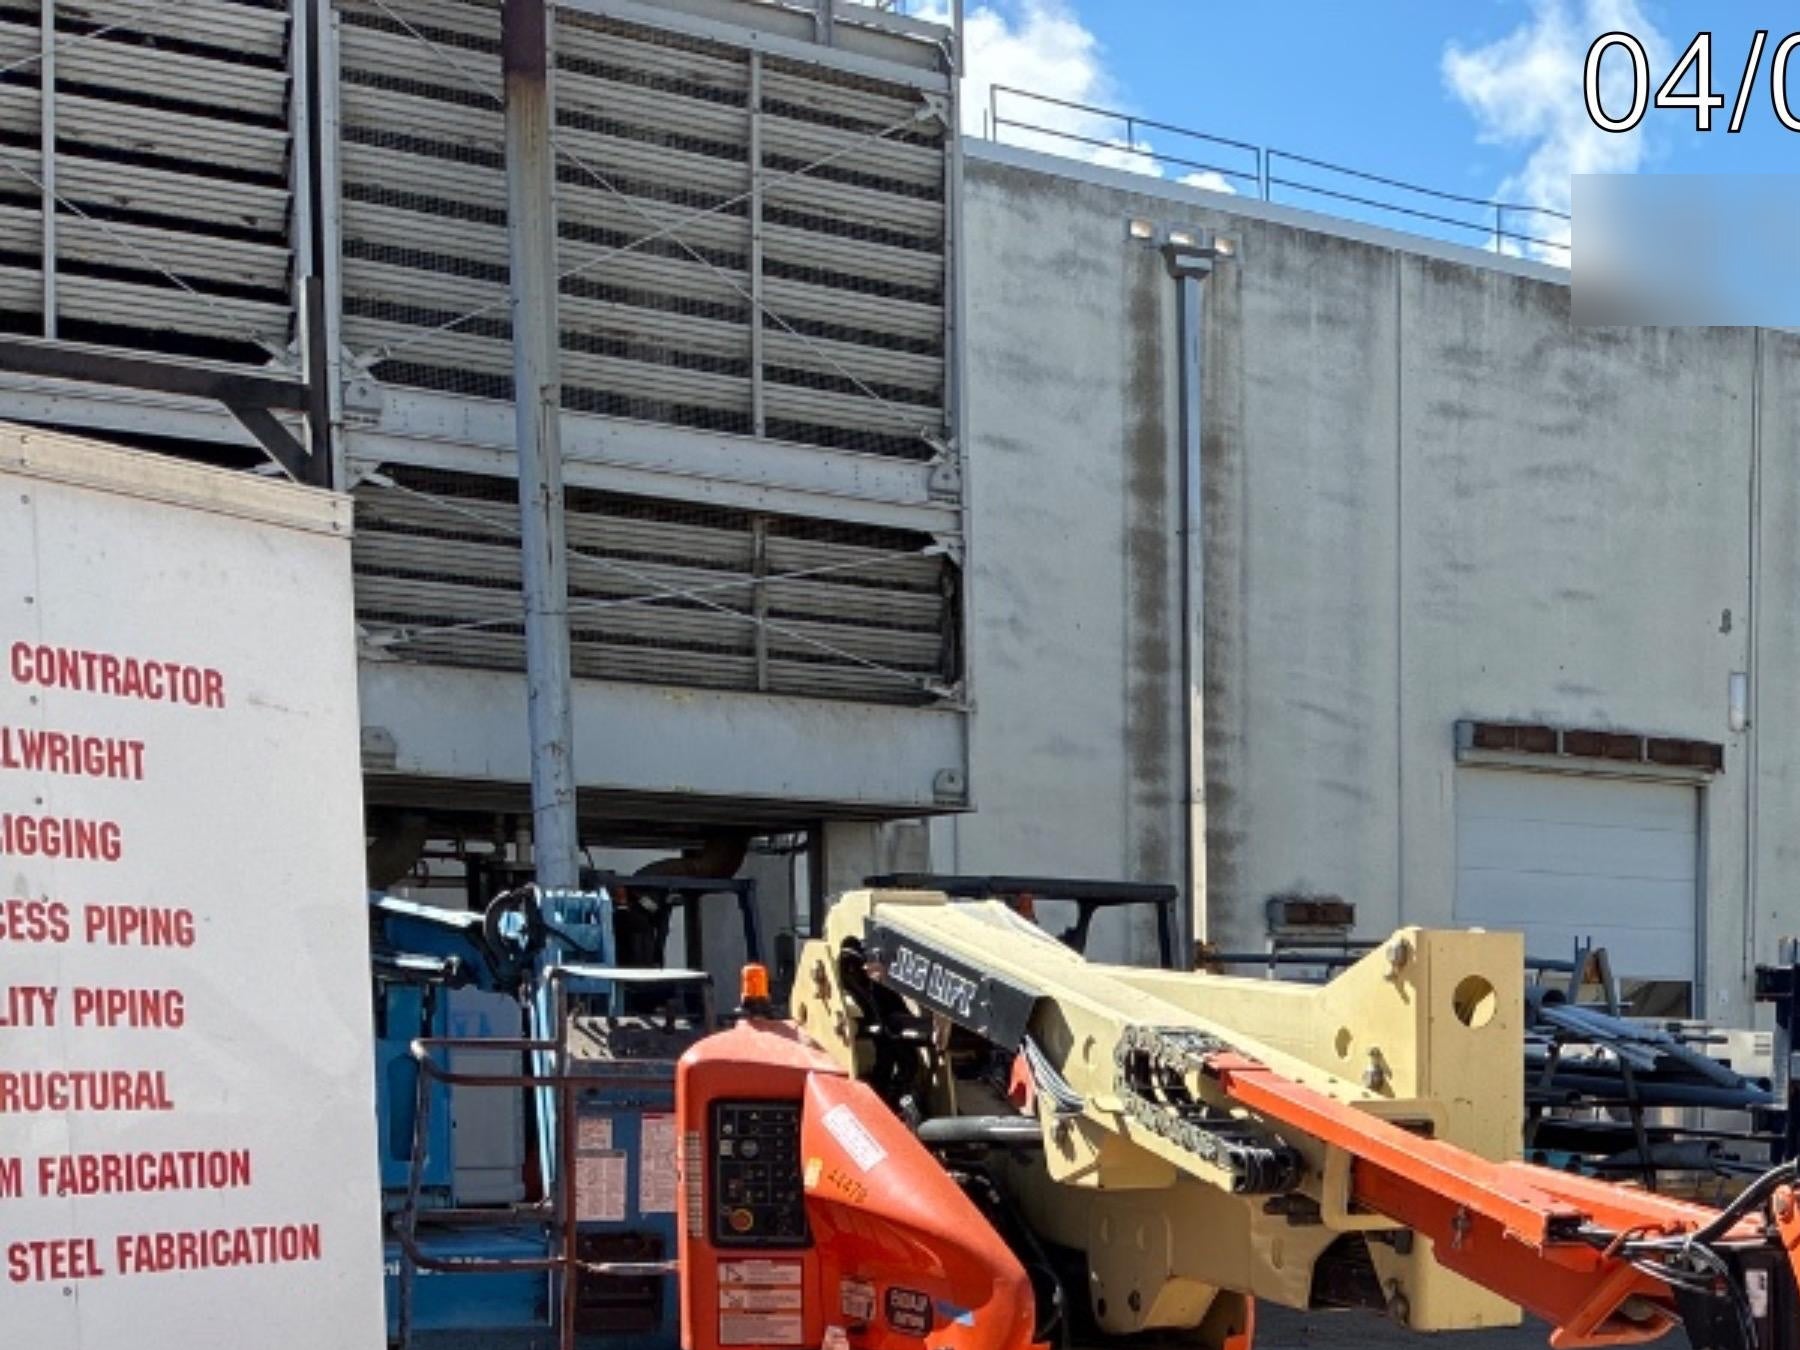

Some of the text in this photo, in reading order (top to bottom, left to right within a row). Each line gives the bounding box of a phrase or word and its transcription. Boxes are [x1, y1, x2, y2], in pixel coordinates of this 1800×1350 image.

[11, 641, 225, 708] CONTRACTOR
[0, 813, 121, 861] IGGING
[85, 904, 195, 947] PIPING
[73, 986, 185, 1028] PIPING
[38, 1149, 251, 1197] FABRICATION
[8, 1223, 321, 1283] STEEL FABRICATION
